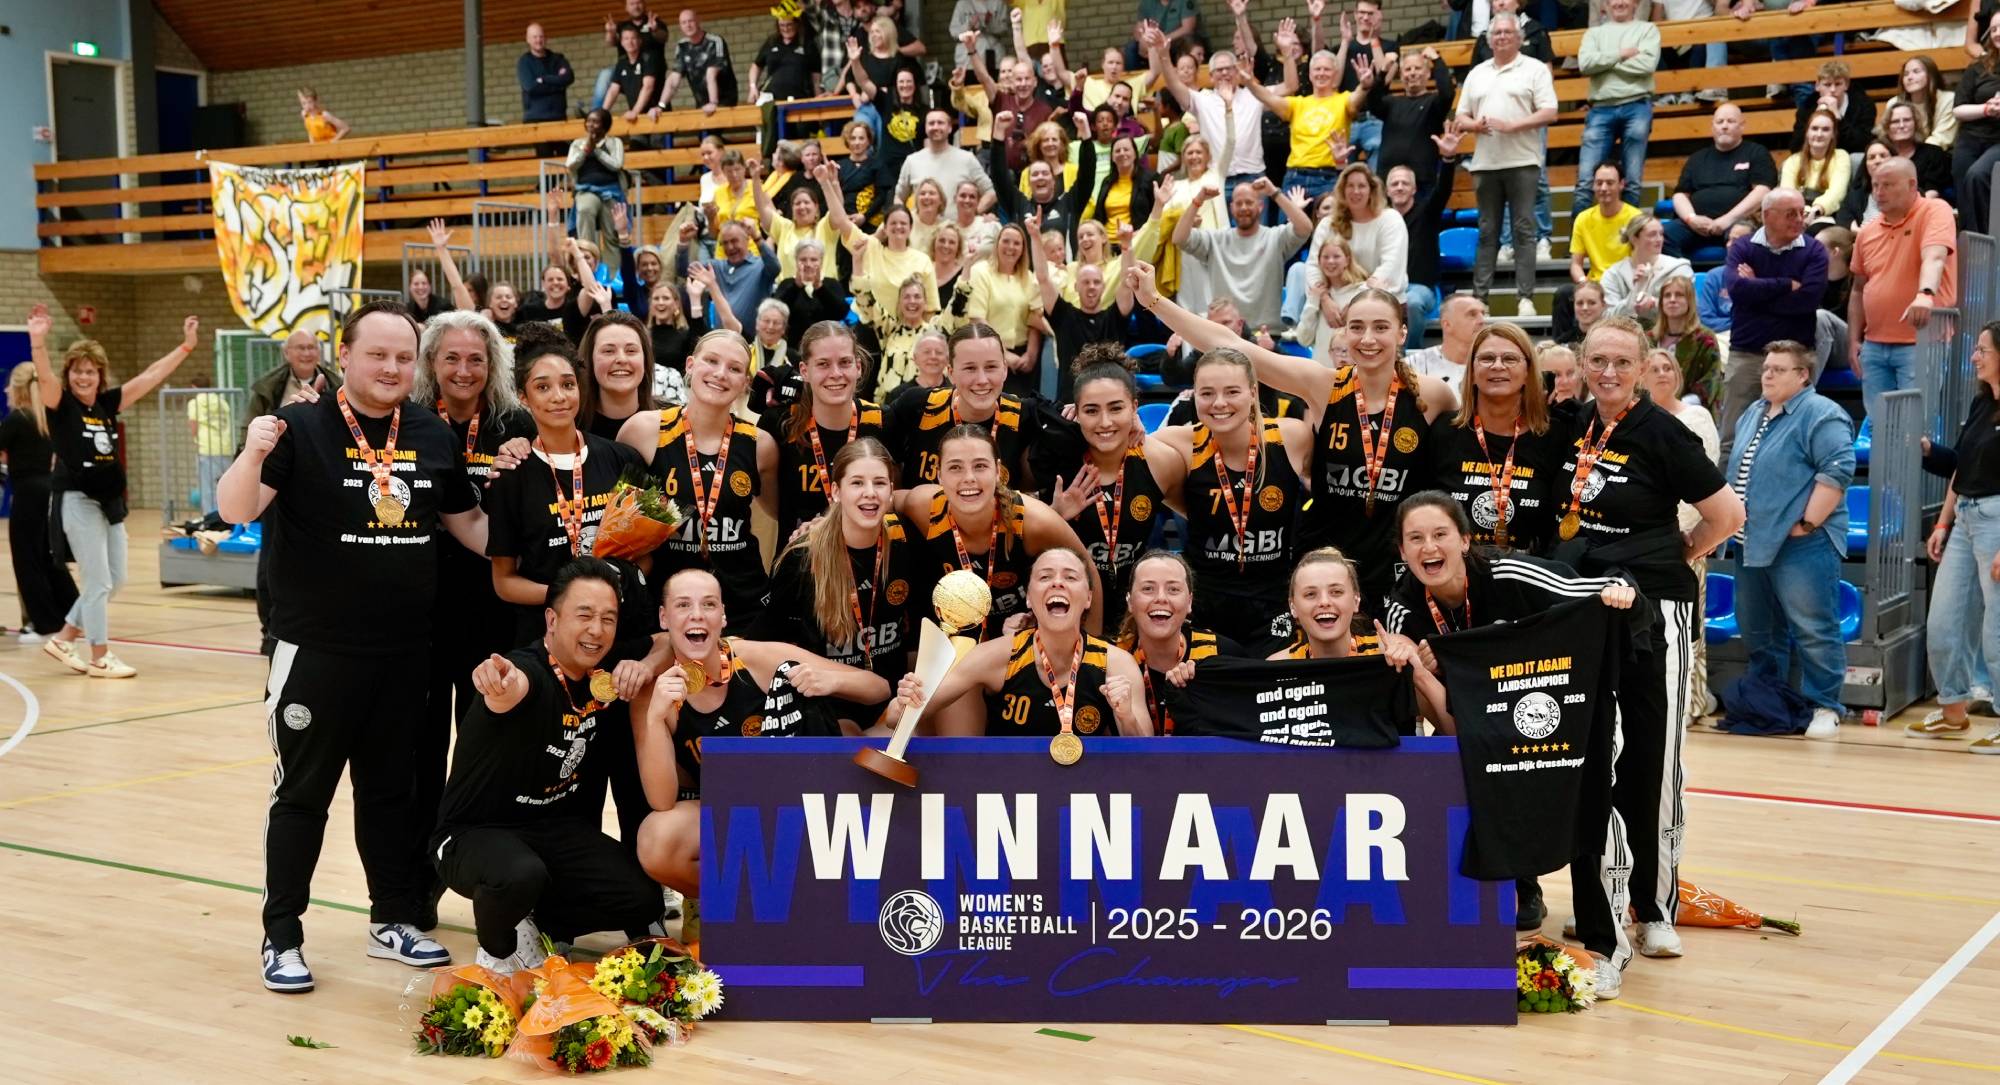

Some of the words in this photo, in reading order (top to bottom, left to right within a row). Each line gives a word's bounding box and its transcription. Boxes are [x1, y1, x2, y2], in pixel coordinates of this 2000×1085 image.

[1329, 422, 1350, 450] 15
[345, 447, 359, 459] WE
[467, 452, 494, 464] AGAIN
[919, 451, 939, 481] 13
[1461, 461, 1475, 472] WE
[343, 479, 363, 488] 2025
[413, 480, 432, 489] 2026
[665, 467, 679, 496] 6
[798, 464, 822, 492] 12
[1209, 488, 1222, 515] 7
[1519, 498, 1540, 508] 2026
[341, 533, 356, 543] GBI
[358, 536, 374, 545] van
[375, 536, 391, 546] Dijk
[549, 537, 567, 547] 2025
[709, 541, 747, 552] ASSENHEIM
[1490, 666, 1505, 680] WE
[1506, 663, 1524, 678] DID
[1525, 661, 1536, 675] IT
[1537, 656, 1572, 673] AGAIN!
[1256, 687, 1283, 704] and
[1284, 681, 1325, 701] again
[1497, 673, 1569, 693] LANDSKAMPIOEN
[1002, 693, 1031, 725] 30
[1259, 706, 1286, 723] and
[1288, 701, 1328, 720] again
[1486, 702, 1508, 713] 2025
[1563, 693, 1586, 704] 2026
[1514, 699, 1560, 737] GRASSHOPPERS
[1263, 723, 1289, 735] and
[546, 744, 566, 758] 2025
[1486, 763, 1501, 773] GBI
[1502, 762, 1518, 772] van
[1518, 760, 1535, 772] Dijk
[802, 793, 1410, 880] WINNAAR
[959, 894, 1043, 912] WOMEN'S
[959, 916, 1078, 935] BASKETBALL
[1107, 908, 1199, 939] 2025
[1240, 908, 1333, 940] 2026
[959, 936, 1012, 951] LEAGUE
